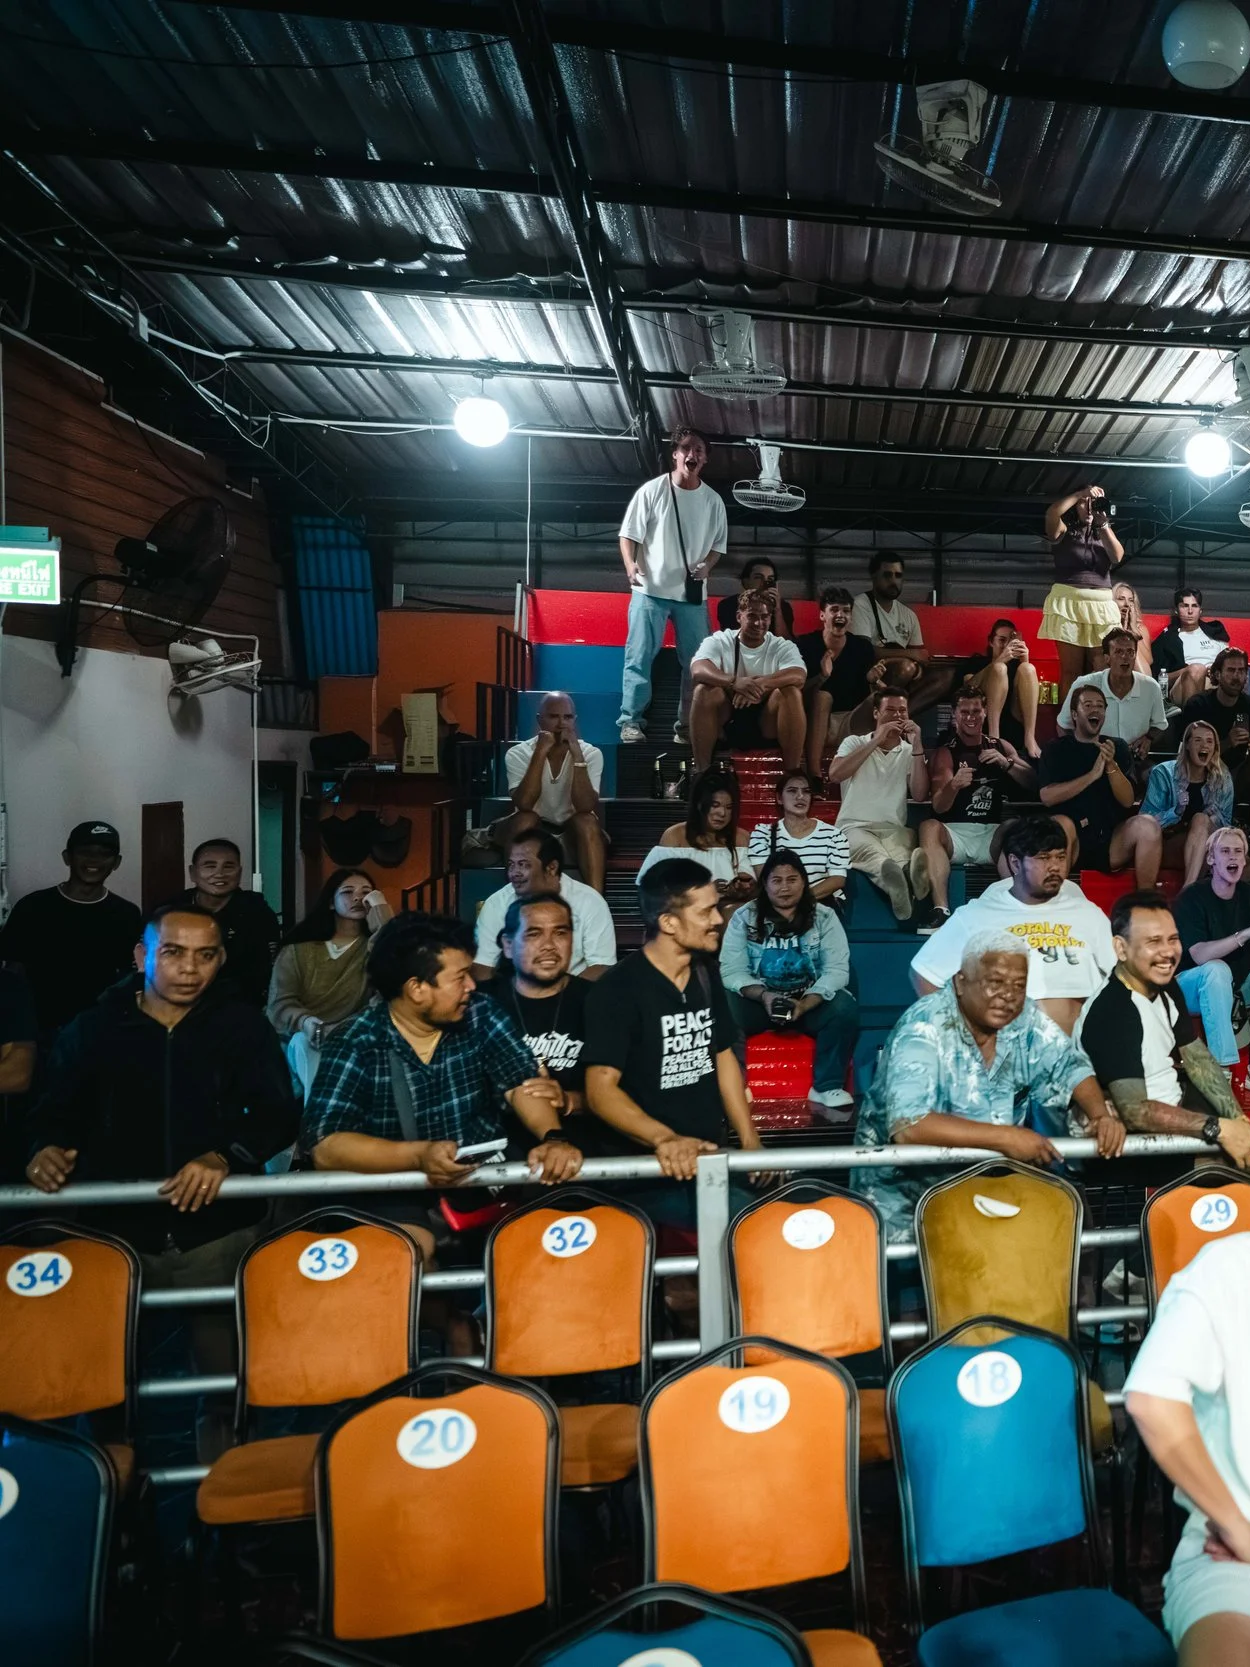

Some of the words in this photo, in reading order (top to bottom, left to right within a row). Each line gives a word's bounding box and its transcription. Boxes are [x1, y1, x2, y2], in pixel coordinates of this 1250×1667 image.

[17, 583, 50, 597] EXIT
[663, 1033, 693, 1055] FOR
[1200, 1198, 1231, 1225] 29
[549, 1222, 589, 1252] 32
[16, 1258, 63, 1290] 34
[308, 1243, 349, 1274] 33
[965, 1360, 1009, 1398] 18
[728, 1387, 777, 1422] 19
[409, 1416, 465, 1456] 20
